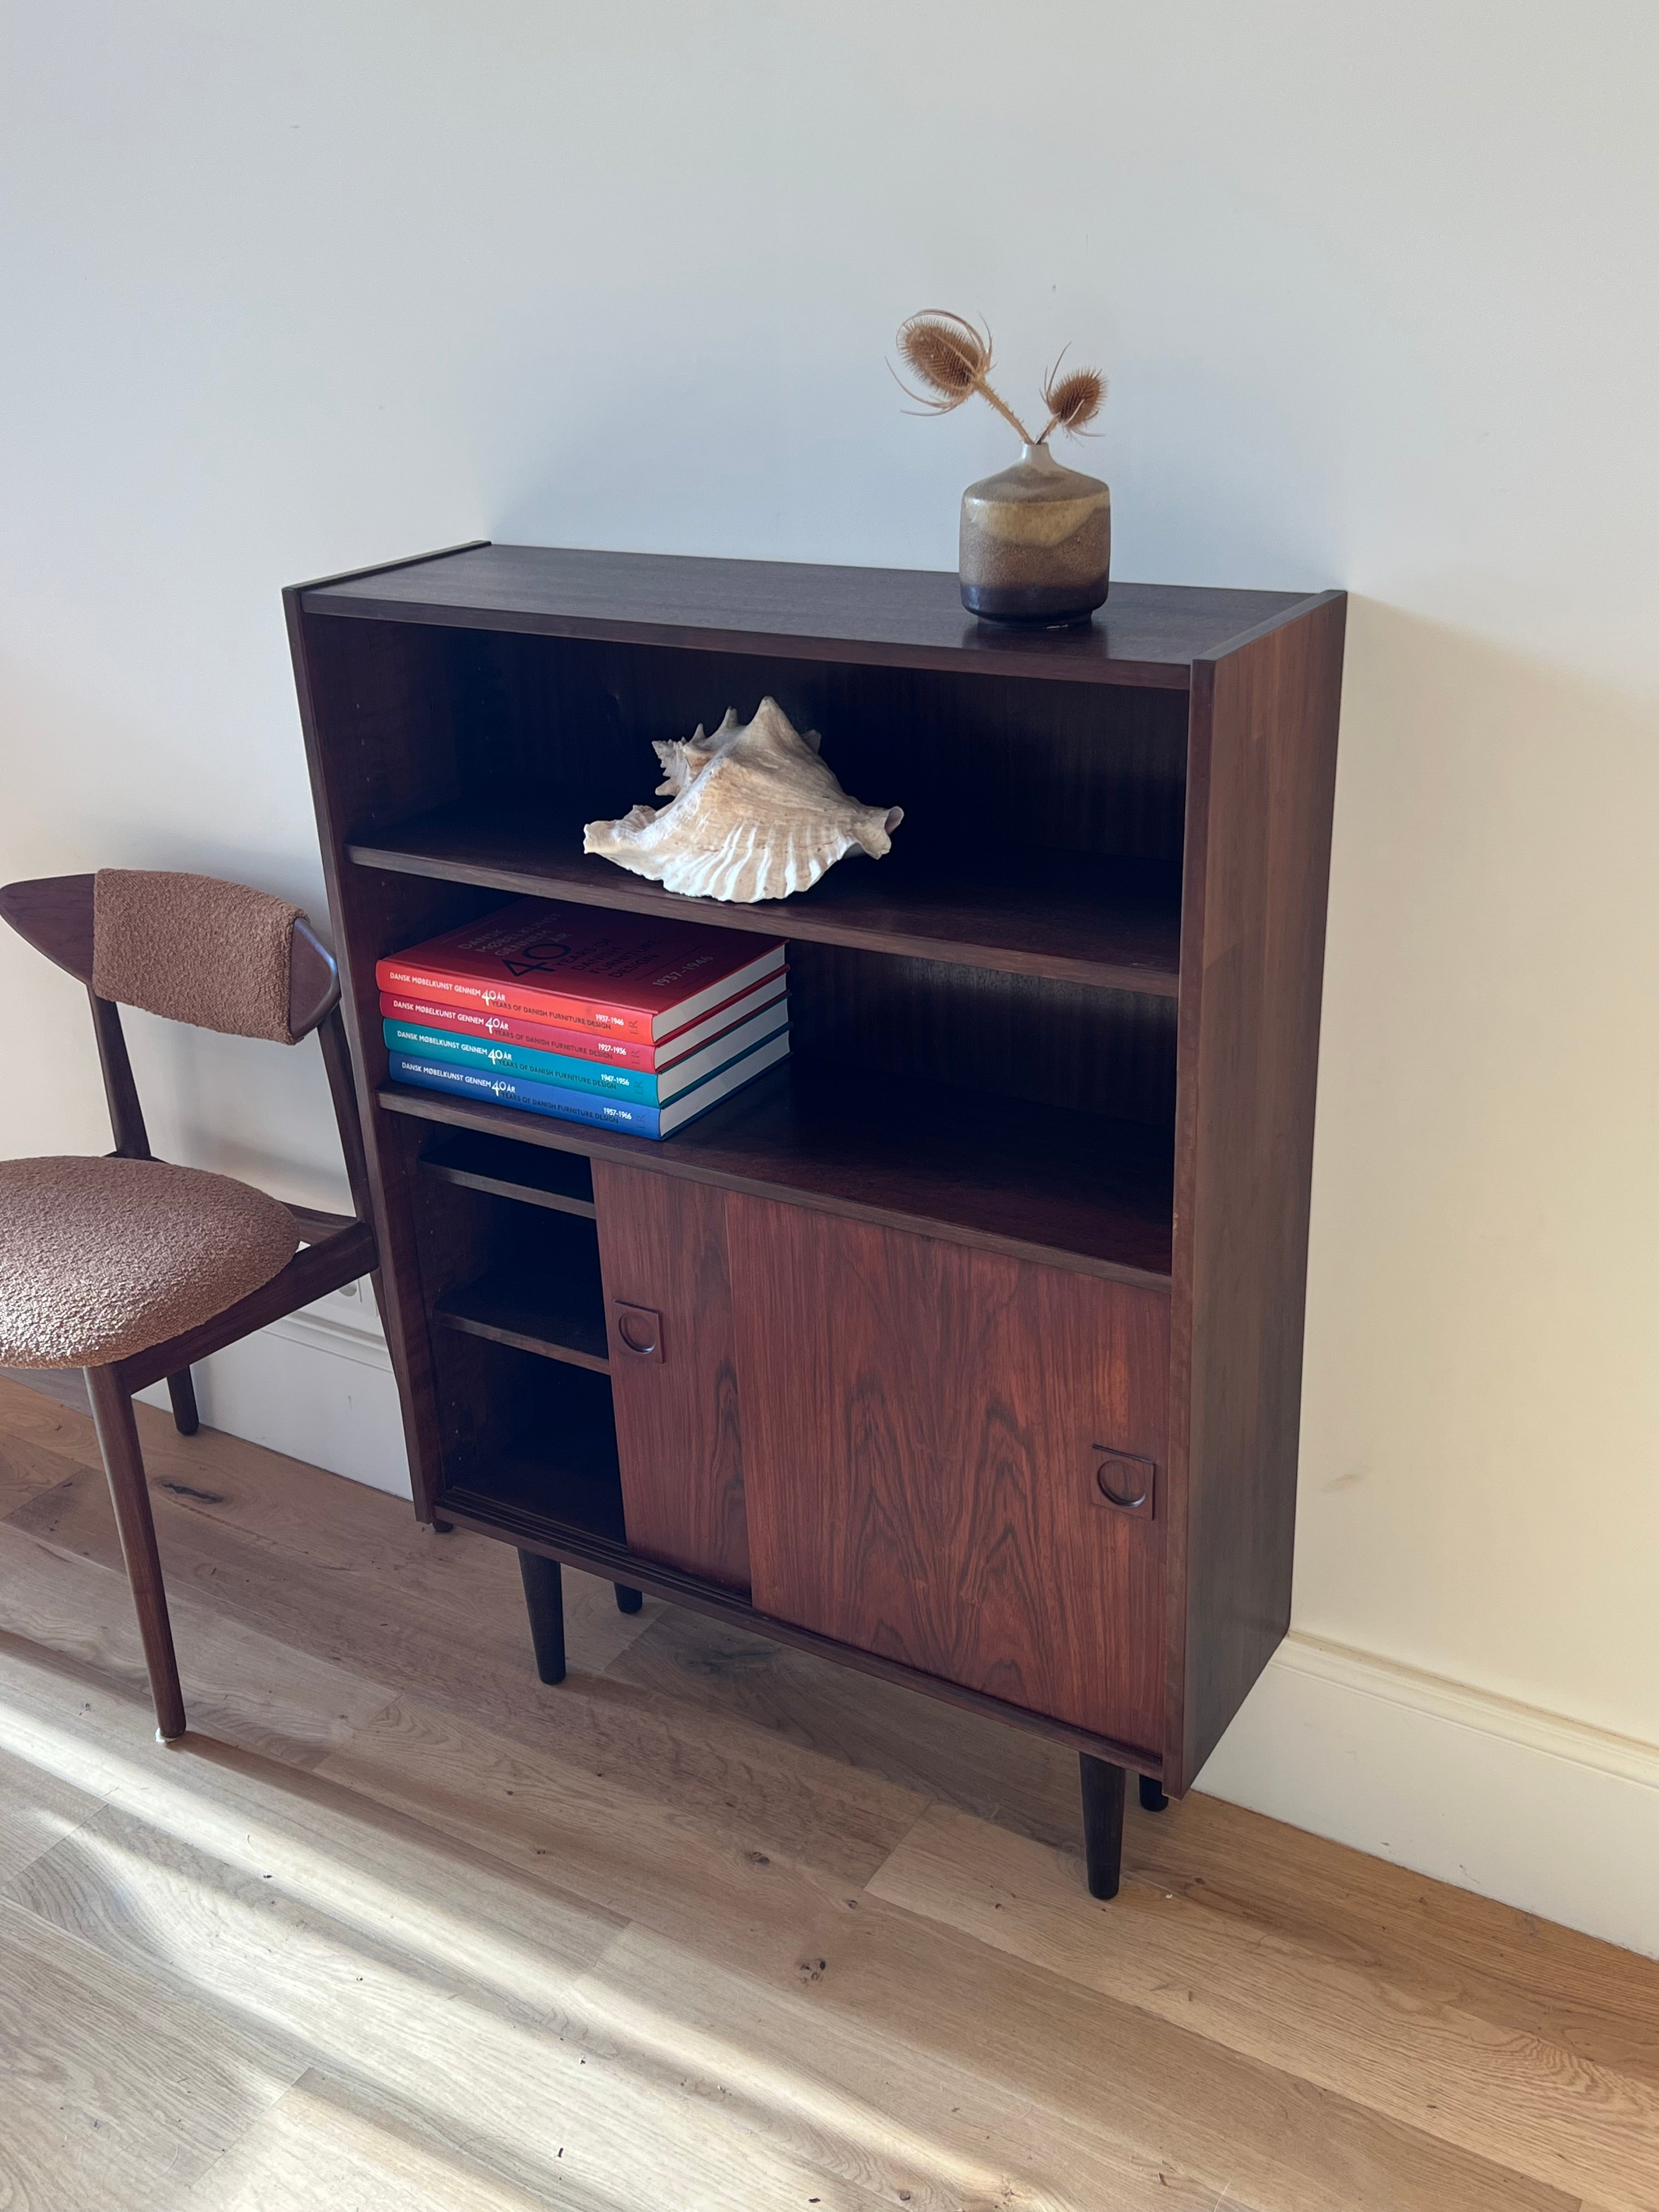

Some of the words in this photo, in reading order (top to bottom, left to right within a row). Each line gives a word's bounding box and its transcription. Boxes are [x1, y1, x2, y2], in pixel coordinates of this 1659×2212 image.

[458, 928, 505, 949] DANSK
[494, 930, 553, 956] GENNEM
[553, 948, 596, 966] YEARS
[594, 938, 612, 947] OF
[502, 943, 571, 977] 40
[571, 947, 623, 970] DANISH
[589, 940, 661, 973] FURNITURE
[608, 955, 659, 977] DESIGN
[390, 972, 410, 983] DANSK
[412, 977, 453, 990] MØBELKUNST
[454, 985, 481, 996] GENNEM
[481, 990, 496, 1006] 40
[393, 1000, 414, 1011] DANSK
[415, 1005, 456, 1019] MØBELKUNST
[458, 1014, 484, 1025] GENNEM
[485, 1017, 500, 1034] 40
[492, 1001, 511, 1010] YEARS
[524, 1007, 548, 1017] DANISH
[549, 1012, 585, 1025] FURNITURE
[587, 1020, 611, 1030] DESIGN
[595, 1014, 624, 1026] 1937-1946
[397, 1030, 417, 1041] DANSK
[419, 1035, 459, 1049] MØBELKUNST
[461, 1044, 487, 1054] GENNEM
[488, 1048, 503, 1065] 40
[494, 1029, 514, 1039] YEARS
[526, 1035, 549, 1046] DANISH
[551, 1041, 587, 1054] FURNITURE
[589, 1049, 613, 1059] DESIGN
[598, 1043, 627, 1056] 1927-1936
[402, 1062, 422, 1072] DANSK
[423, 1067, 464, 1081] MØBELKUNST
[465, 1076, 491, 1087] GENNEM
[492, 1080, 506, 1096] 40
[498, 1059, 517, 1069] YEARS
[529, 1066, 554, 1076] DANISH
[555, 1071, 591, 1084] FURNITURE
[592, 1079, 616, 1090] DESIGN
[601, 1074, 630, 1086] 1947-1956
[500, 1092, 521, 1102] YEARS
[532, 1099, 556, 1110] DANISH
[558, 1105, 594, 1118] FURNITURE
[595, 1113, 619, 1124] DESIGN
[603, 1107, 631, 1120] 1957-1966
